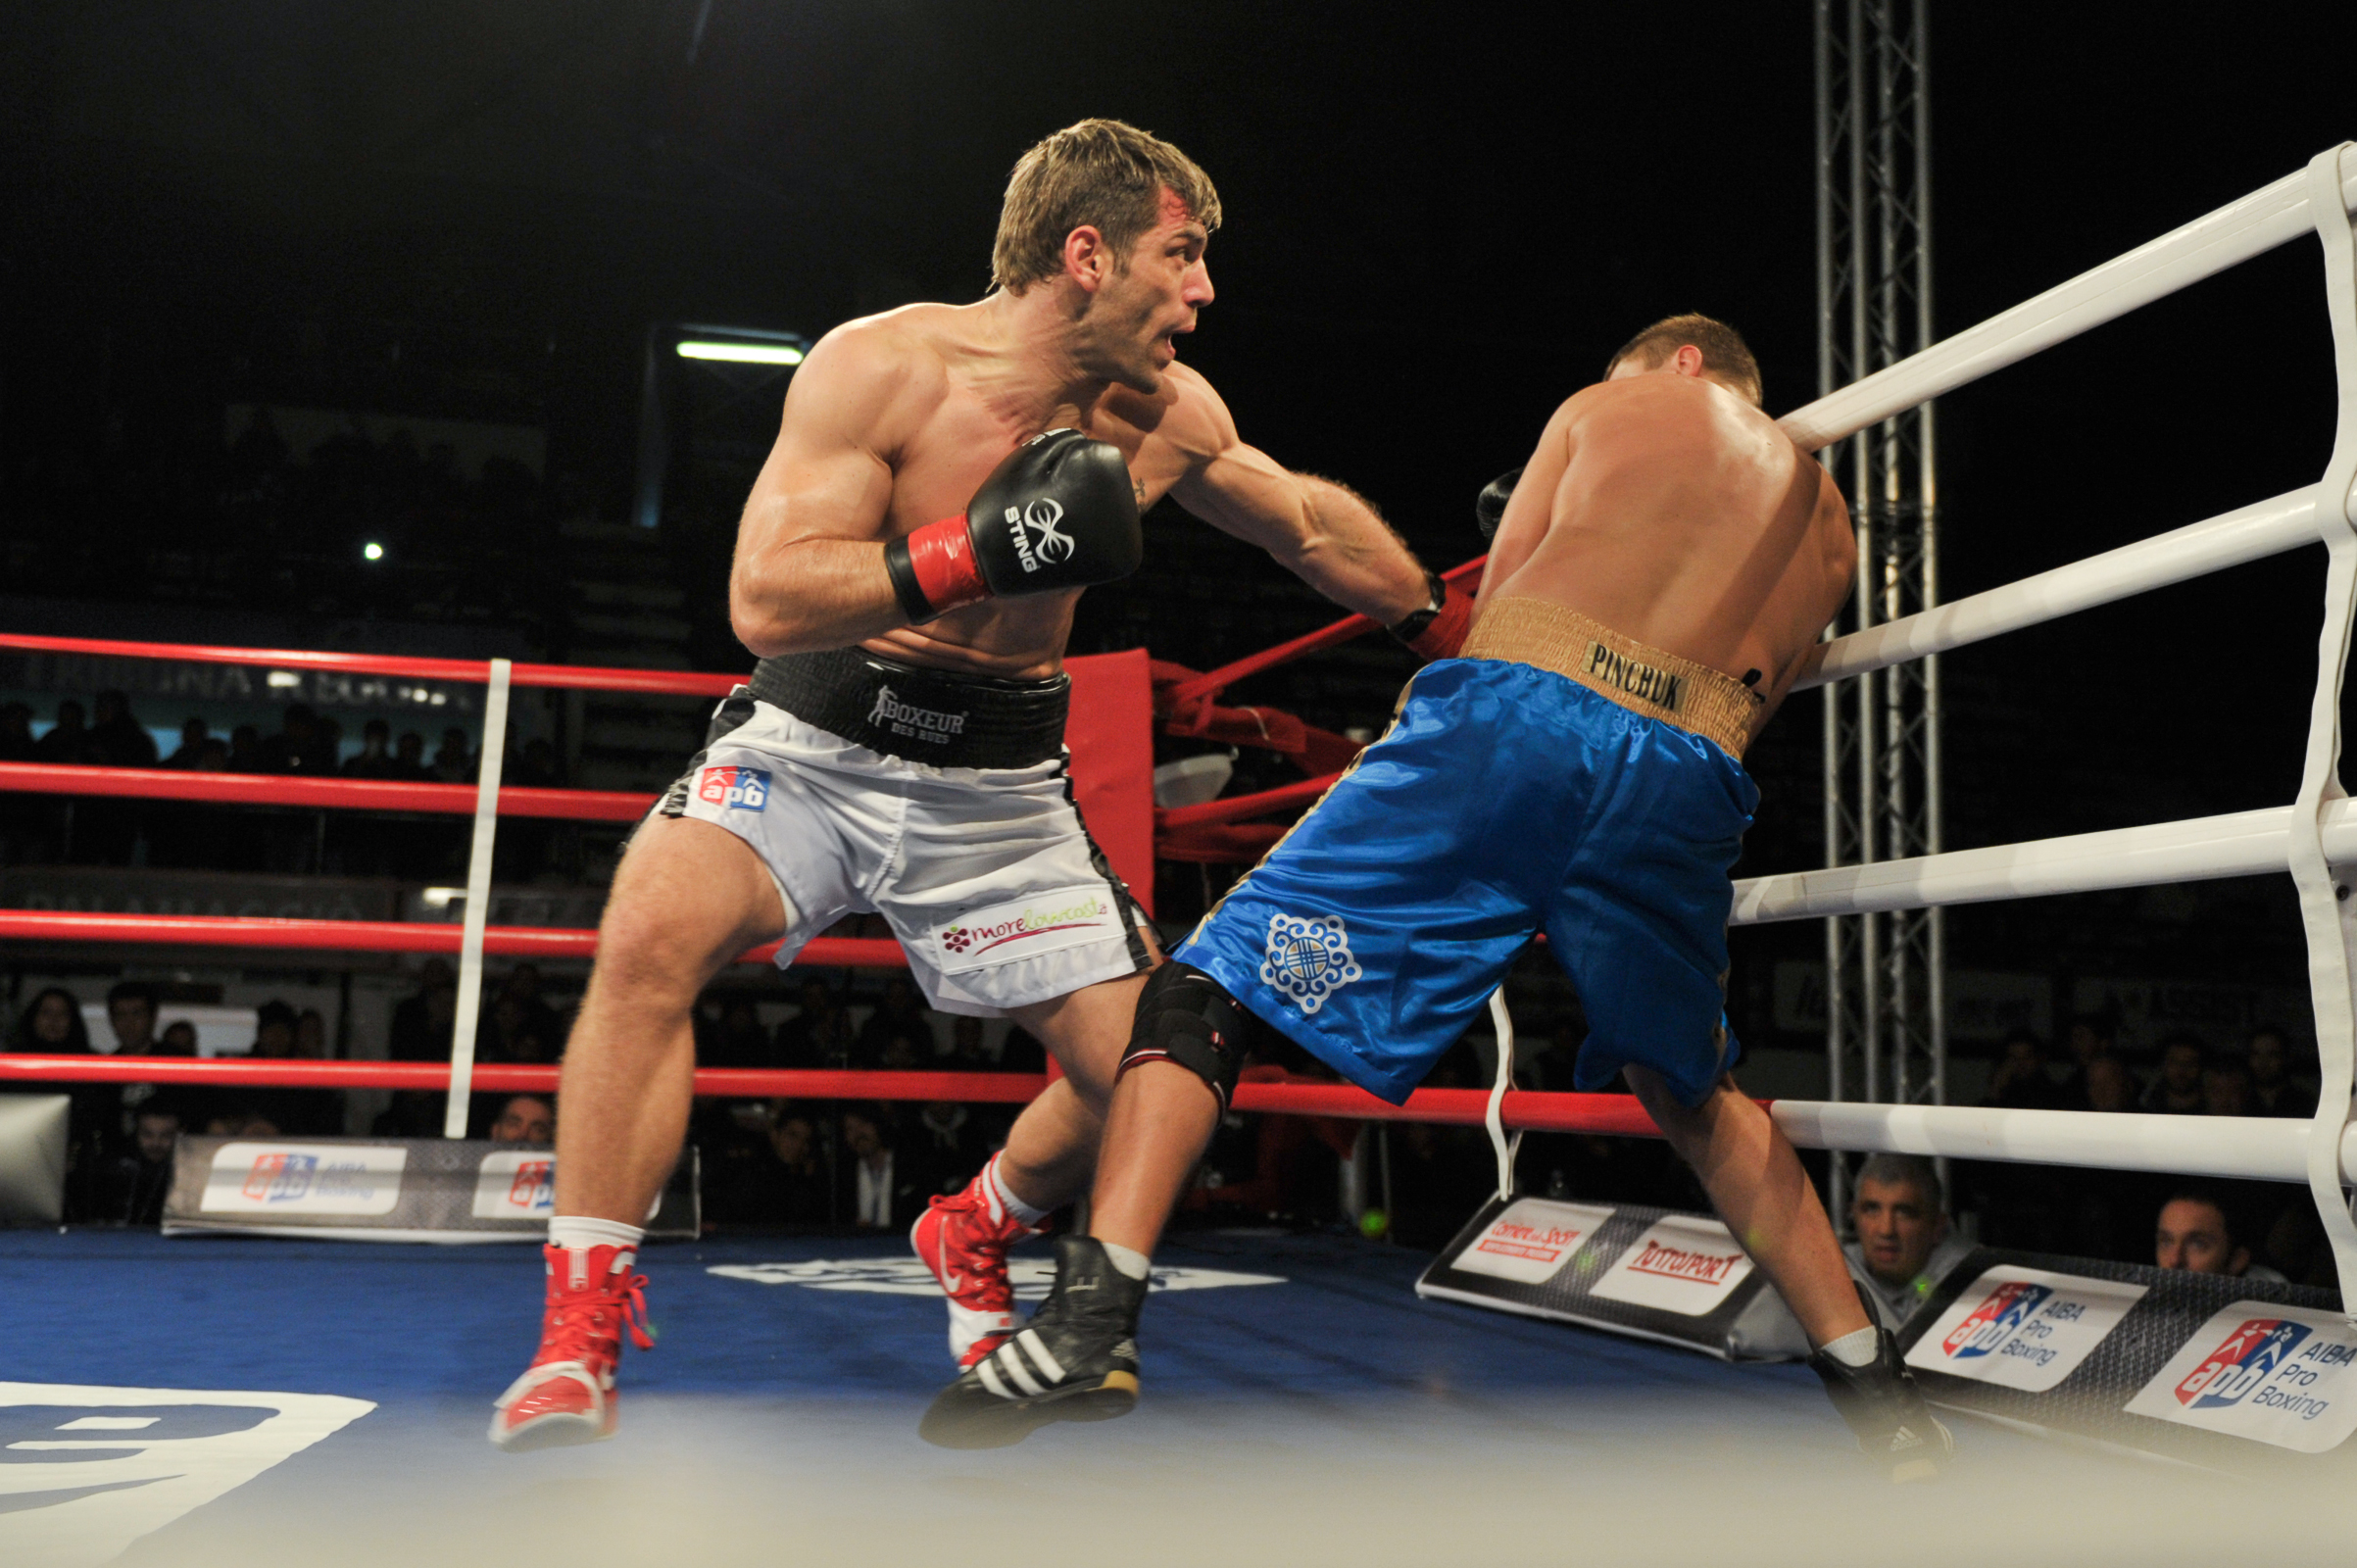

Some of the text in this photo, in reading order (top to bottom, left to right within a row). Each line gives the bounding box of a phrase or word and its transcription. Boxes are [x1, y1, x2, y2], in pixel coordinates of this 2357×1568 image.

[1005, 506, 1038, 573] STING
[1590, 643, 1682, 710] PINCHUK
[883, 699, 964, 734] BOXEUR
[891, 722, 951, 745] DES RUES
[702, 784, 764, 809] apb
[2038, 1300, 2087, 1322] AIBA
[2020, 1319, 2053, 1339] Pro
[2000, 1339, 2057, 1366] Boxing
[2298, 1342, 2357, 1367] AIBA
[2275, 1363, 2318, 1386] Pro
[2252, 1386, 2330, 1420] Boxing
